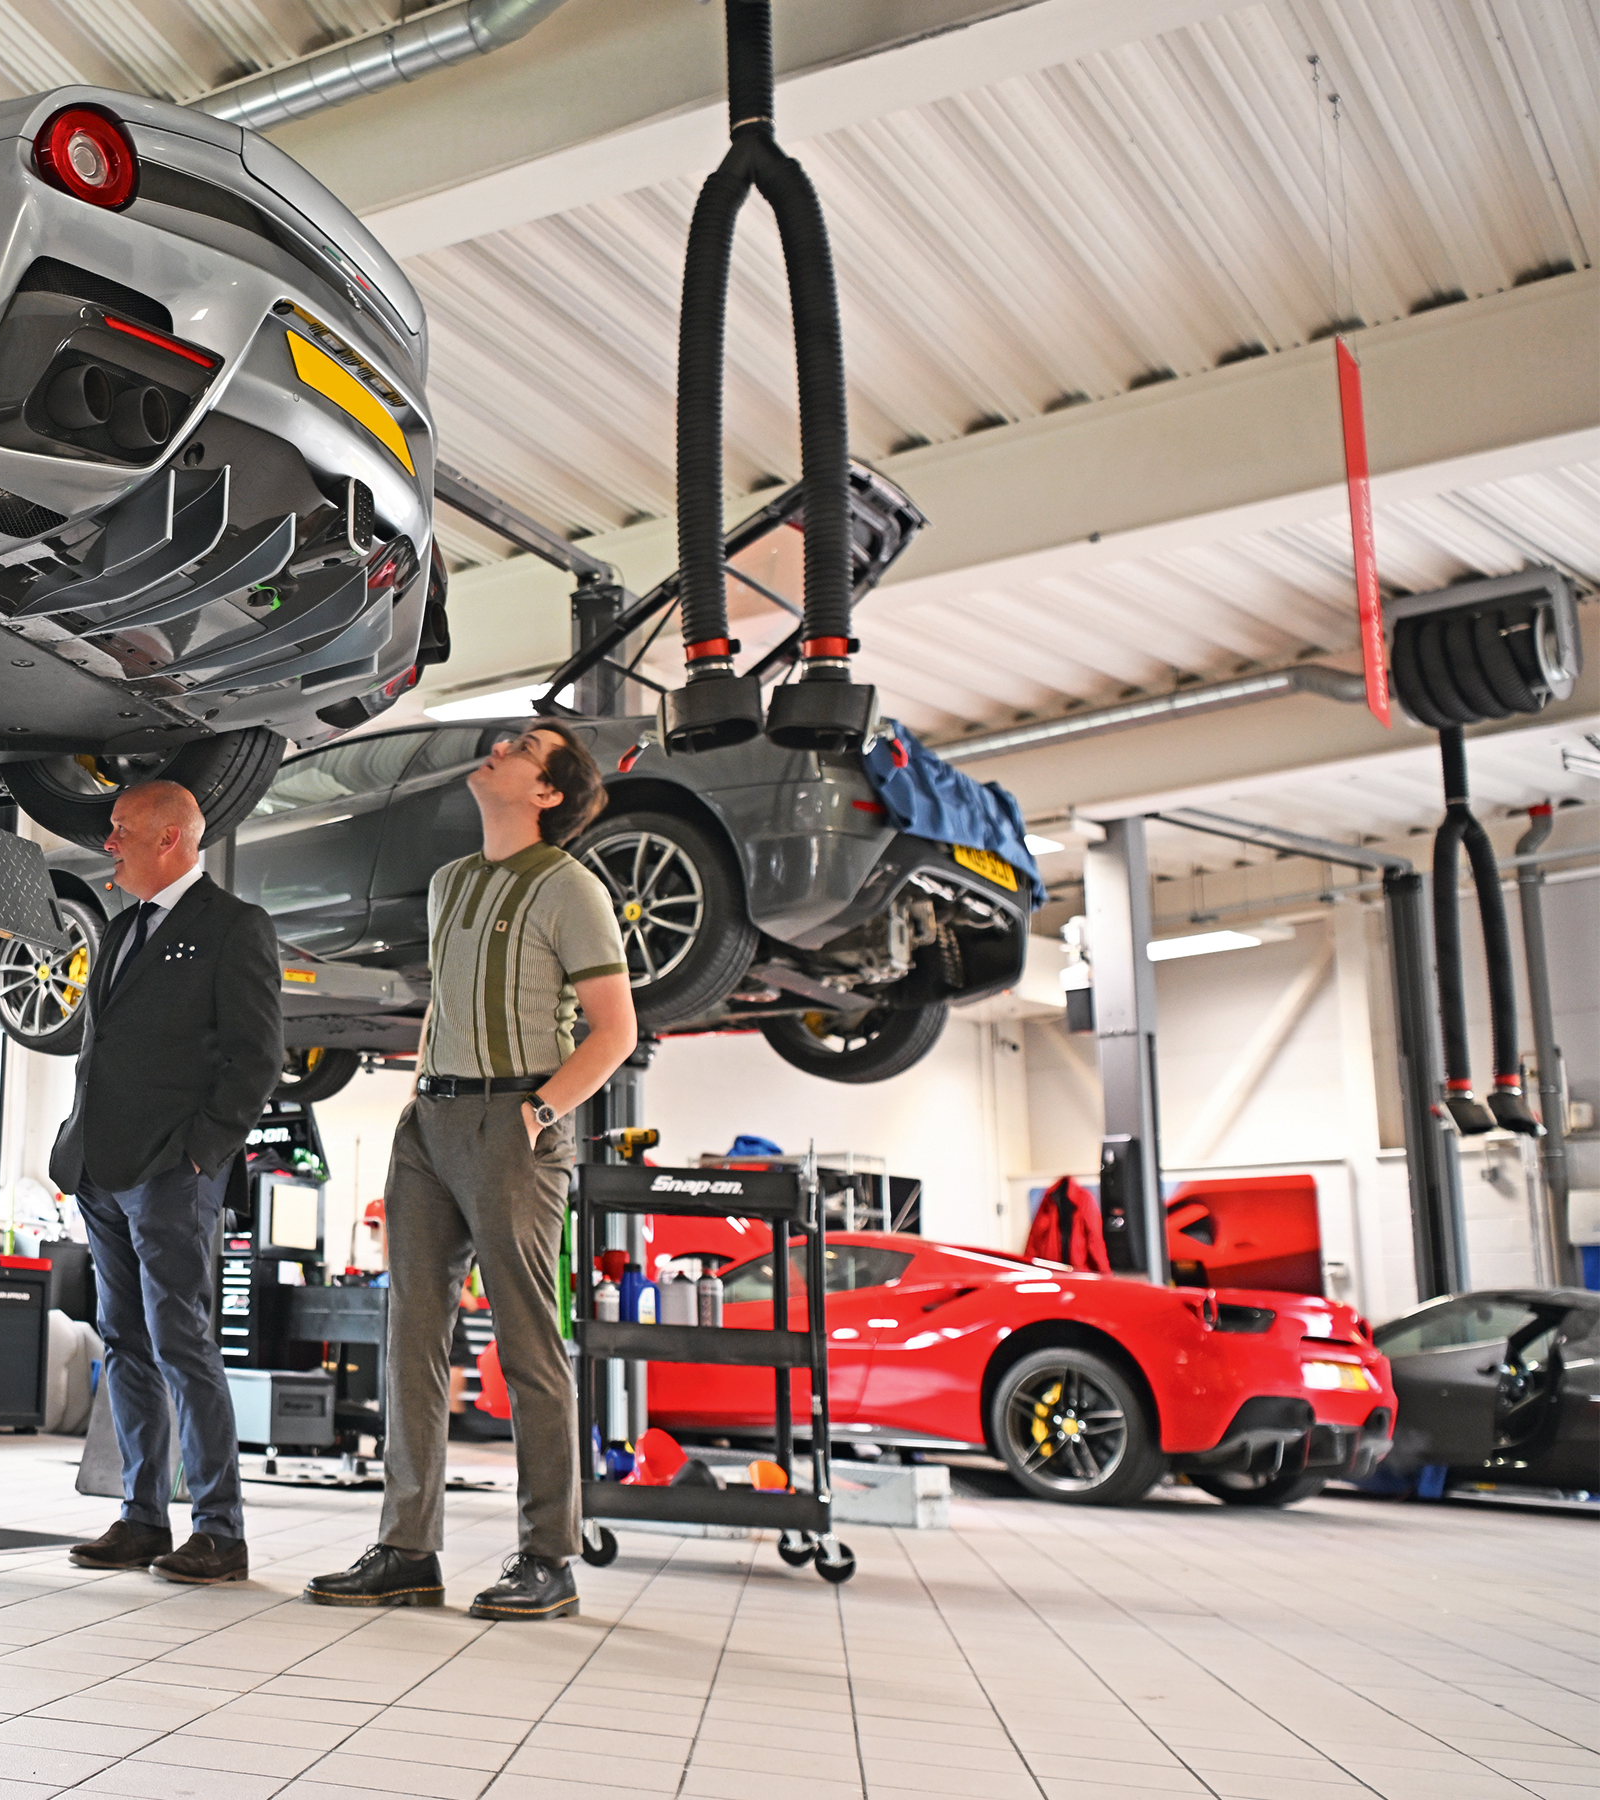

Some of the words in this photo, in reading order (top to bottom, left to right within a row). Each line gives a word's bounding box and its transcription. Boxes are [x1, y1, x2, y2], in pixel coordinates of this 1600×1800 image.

[1359, 478, 1375, 554] AREA
[1366, 556, 1388, 711] DIAGNOSIS
[245, 1127, 288, 1145] p-on
[649, 1174, 743, 1196] Snap-on
